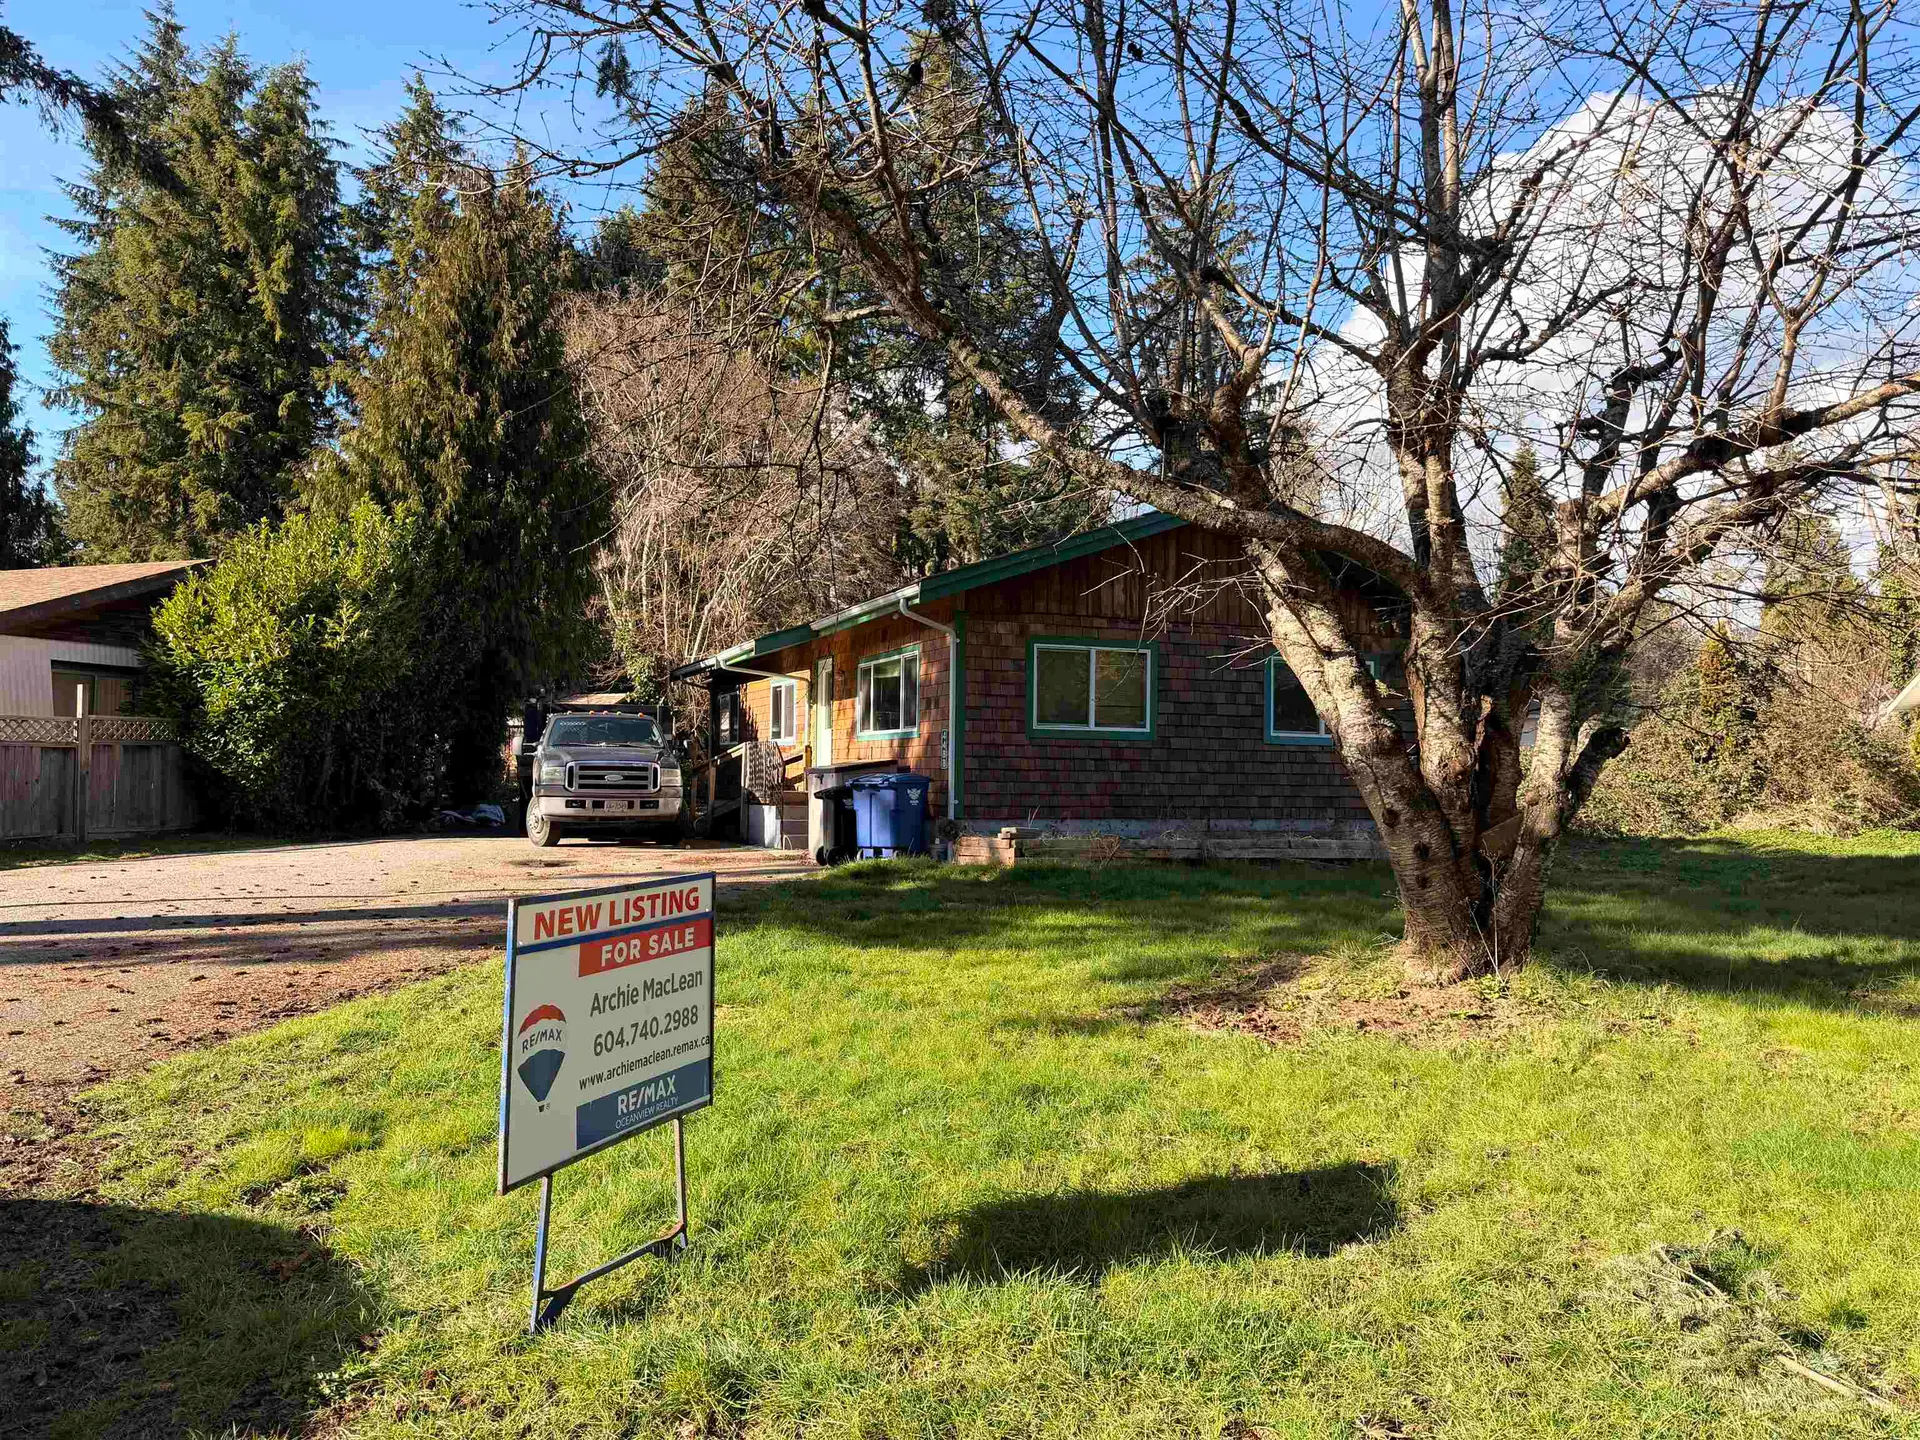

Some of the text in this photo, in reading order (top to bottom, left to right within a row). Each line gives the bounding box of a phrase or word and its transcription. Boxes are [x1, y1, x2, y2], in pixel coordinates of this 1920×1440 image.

[534, 887, 699, 940] NEW LISTING
[600, 926, 695, 967] FOR SALE
[590, 970, 703, 1017] Archie MacLean
[521, 1028, 563, 1054] RE/MAX
[593, 1004, 699, 1057] 604.740.2988
[579, 1035, 710, 1090] www.archiemaclean.remax.ca
[615, 1096, 679, 1129] OCEANVIEW REALTY
[617, 1074, 677, 1115] RE/MAX
